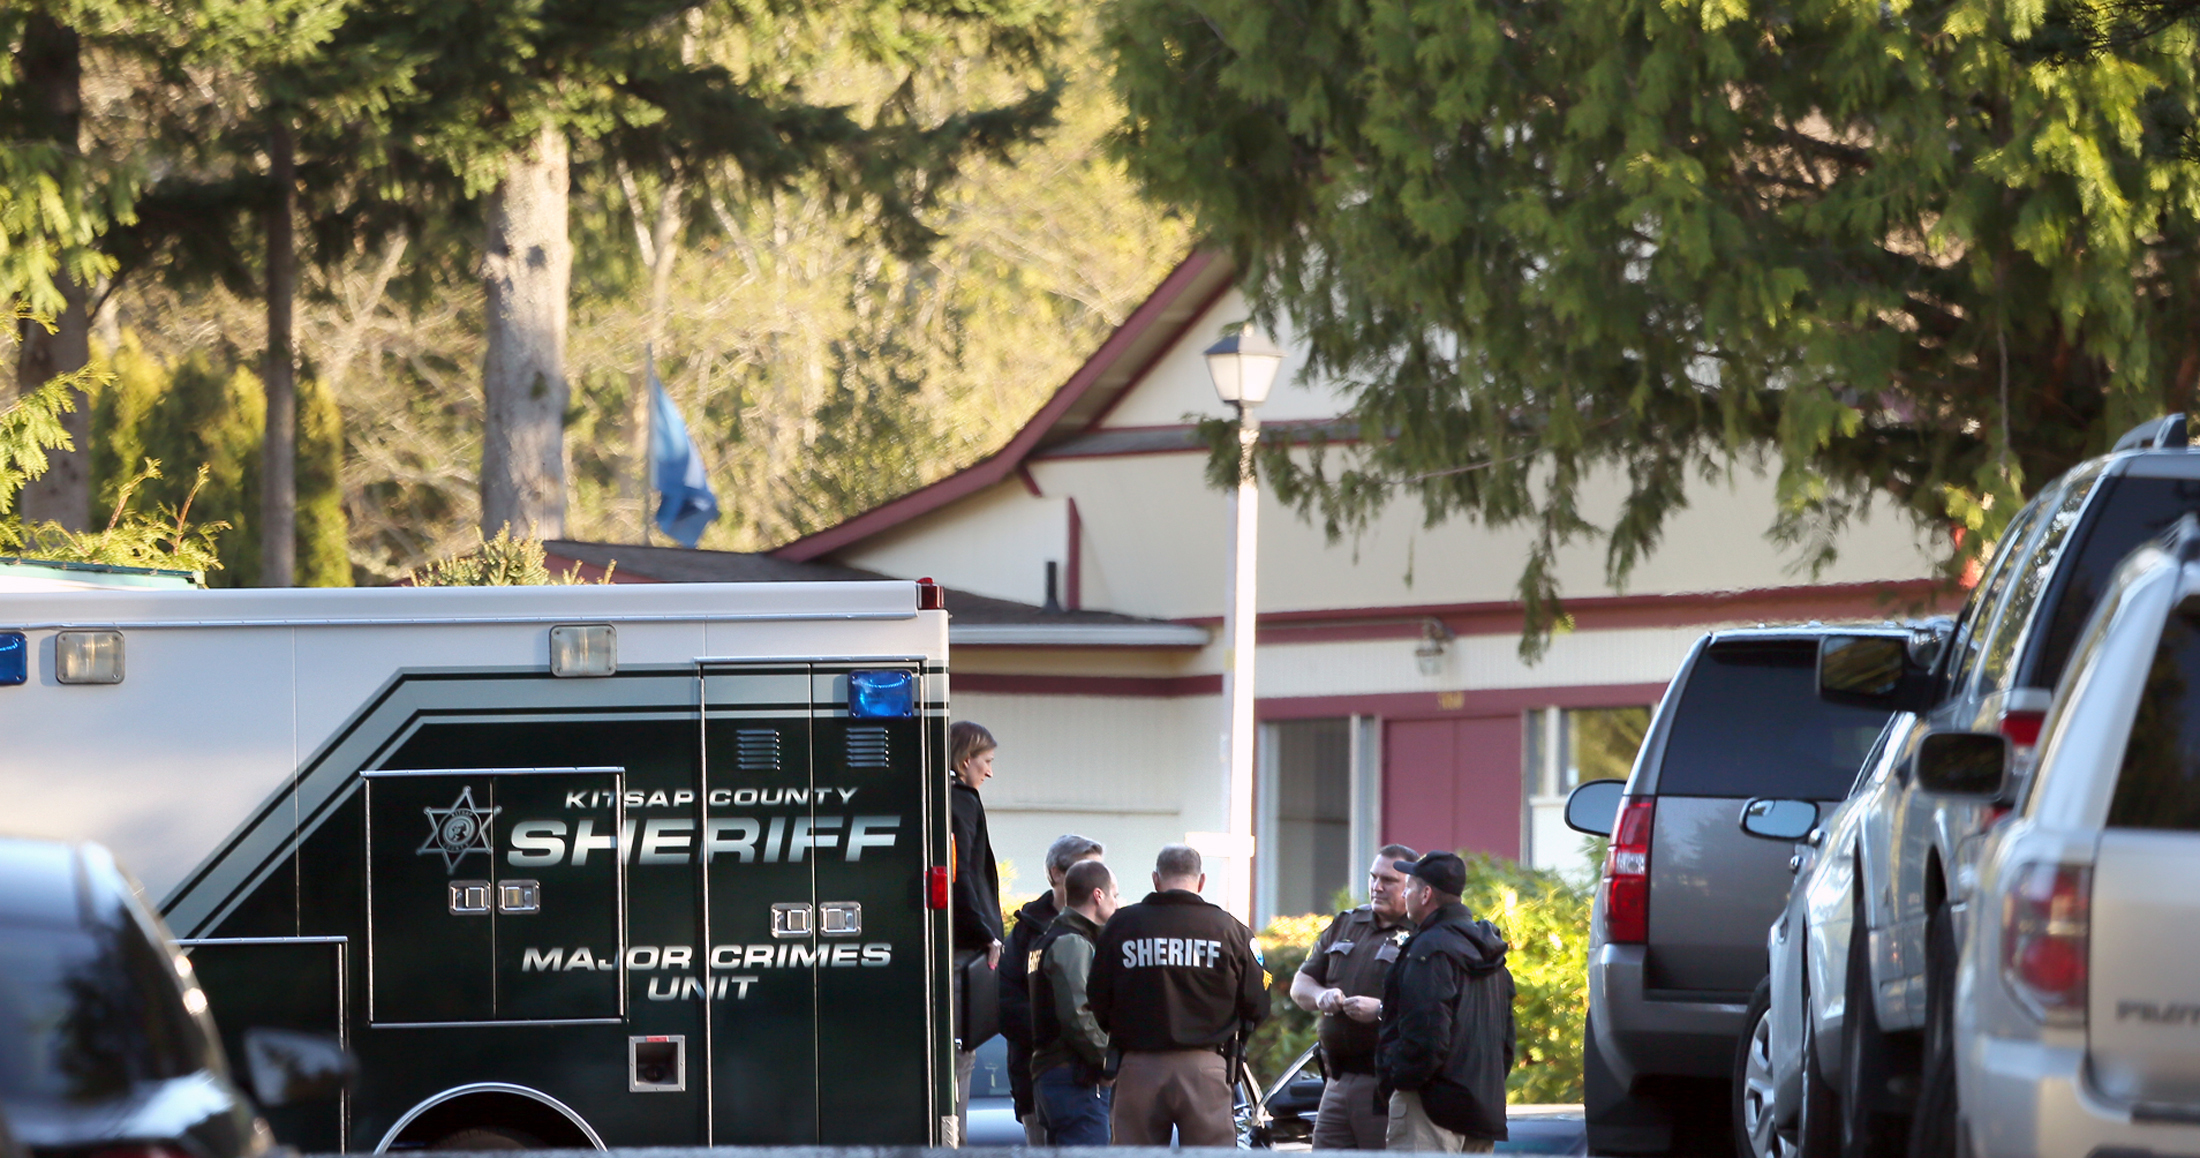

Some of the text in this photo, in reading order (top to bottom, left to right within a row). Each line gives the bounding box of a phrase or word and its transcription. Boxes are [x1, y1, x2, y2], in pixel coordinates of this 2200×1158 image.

[565, 787, 858, 809] KITSAP COUNTY
[507, 815, 901, 866] SHERIFF
[522, 943, 892, 972] MAJOR CRIMES
[1121, 937, 1222, 969] SHERIFF
[647, 976, 759, 1000] UNIT
